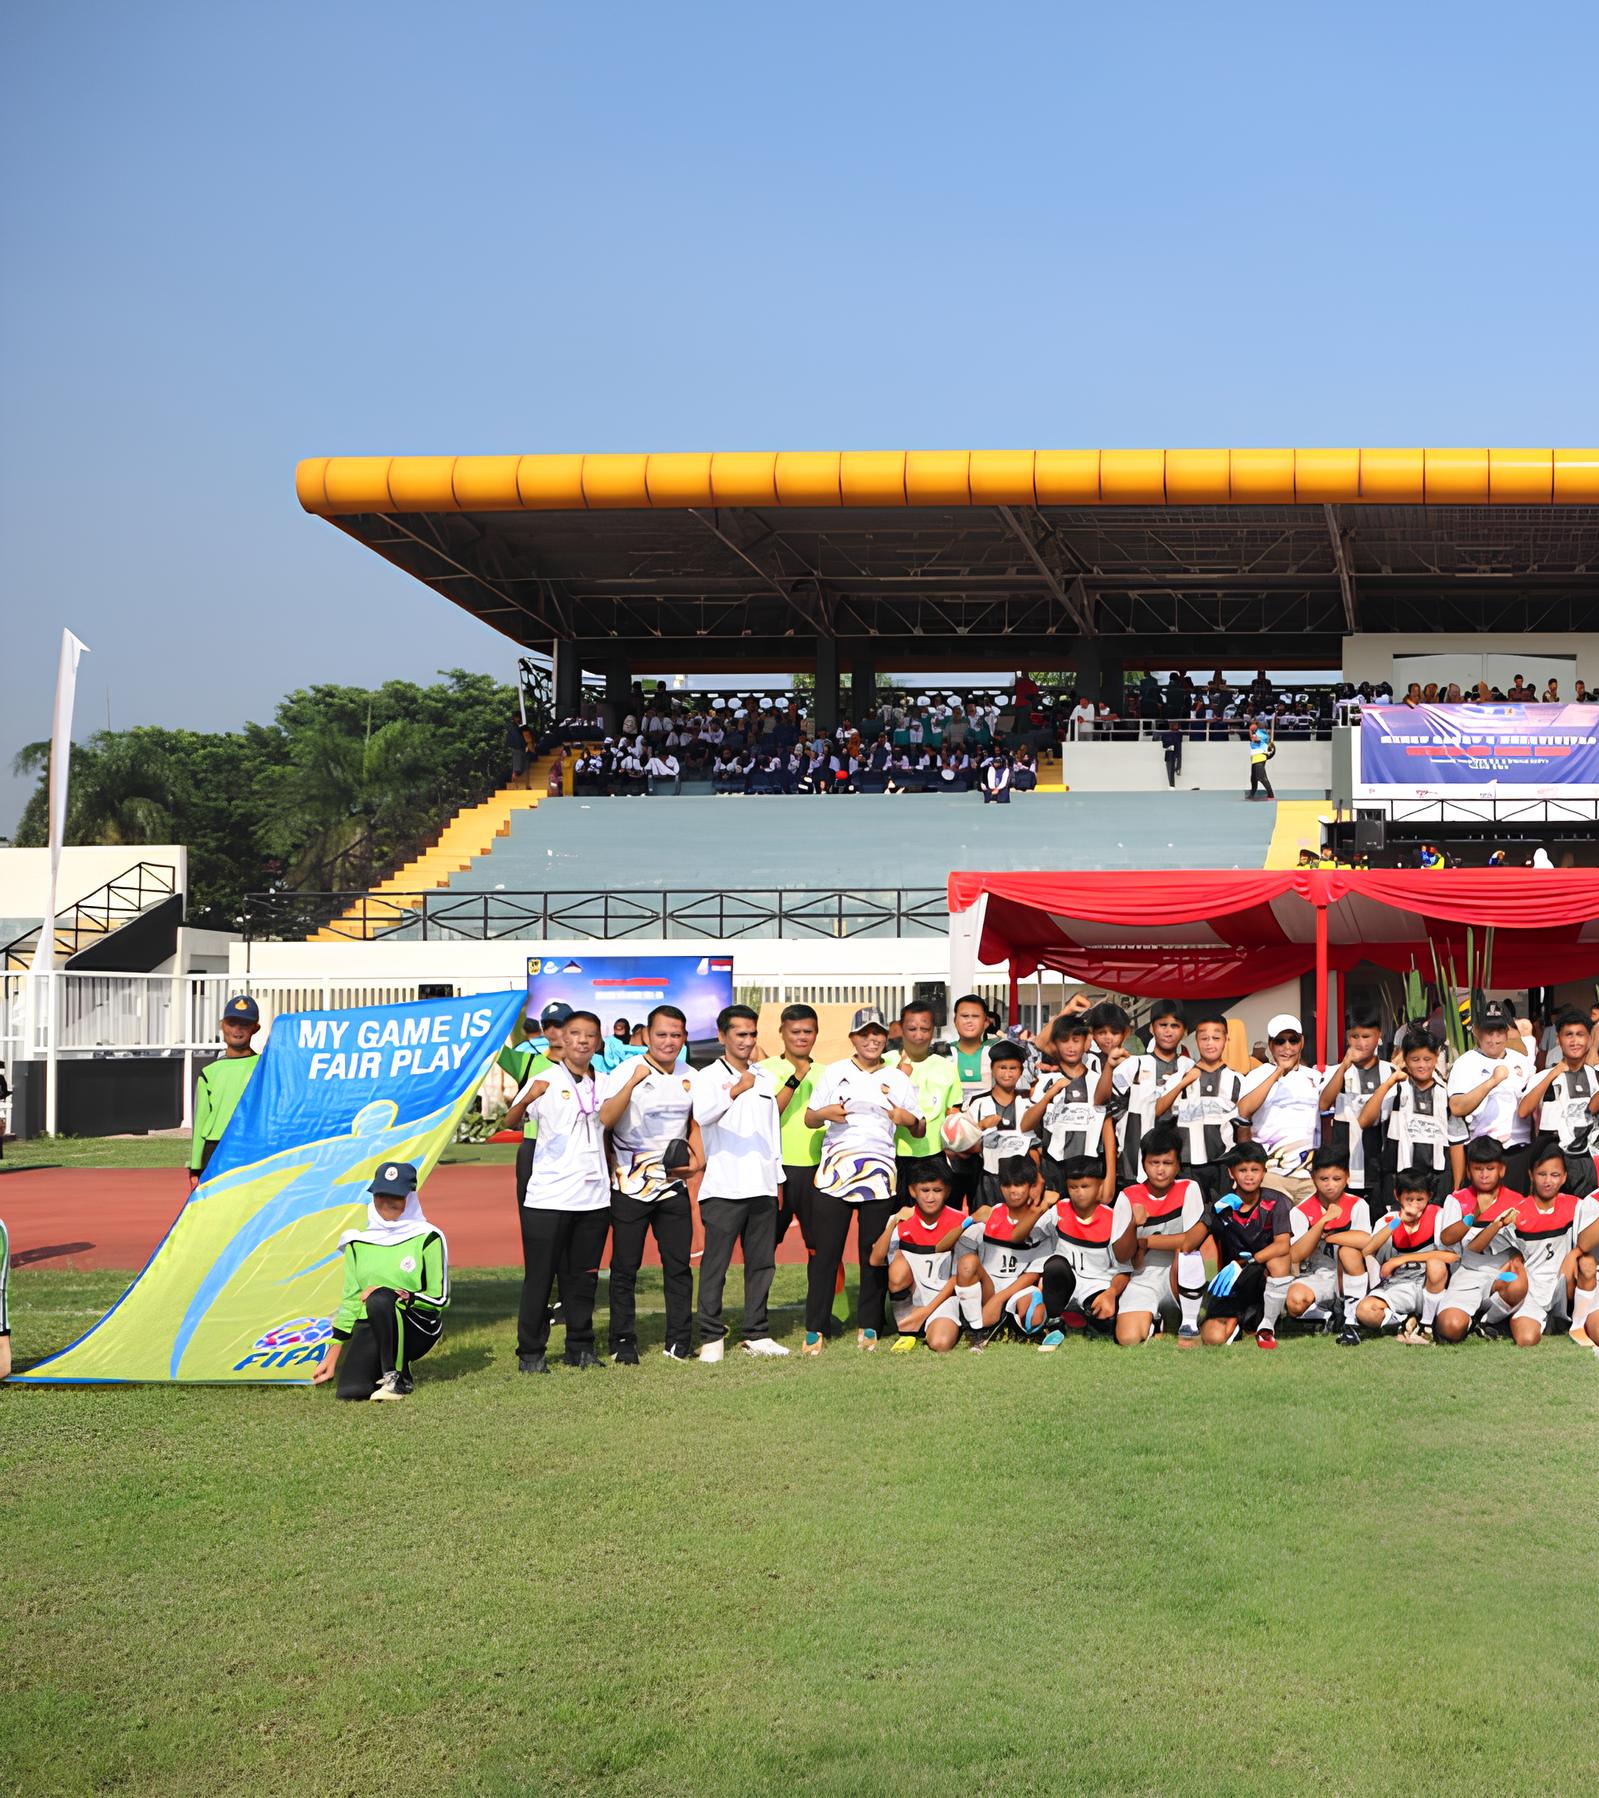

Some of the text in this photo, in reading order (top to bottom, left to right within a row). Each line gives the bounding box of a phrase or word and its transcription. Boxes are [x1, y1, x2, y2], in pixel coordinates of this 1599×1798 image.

[298, 1008, 493, 1049] MY GAME IS
[308, 1041, 471, 1080] FAIR PLAY
[925, 1259, 934, 1279] 7
[232, 1342, 328, 1372] FIFA
